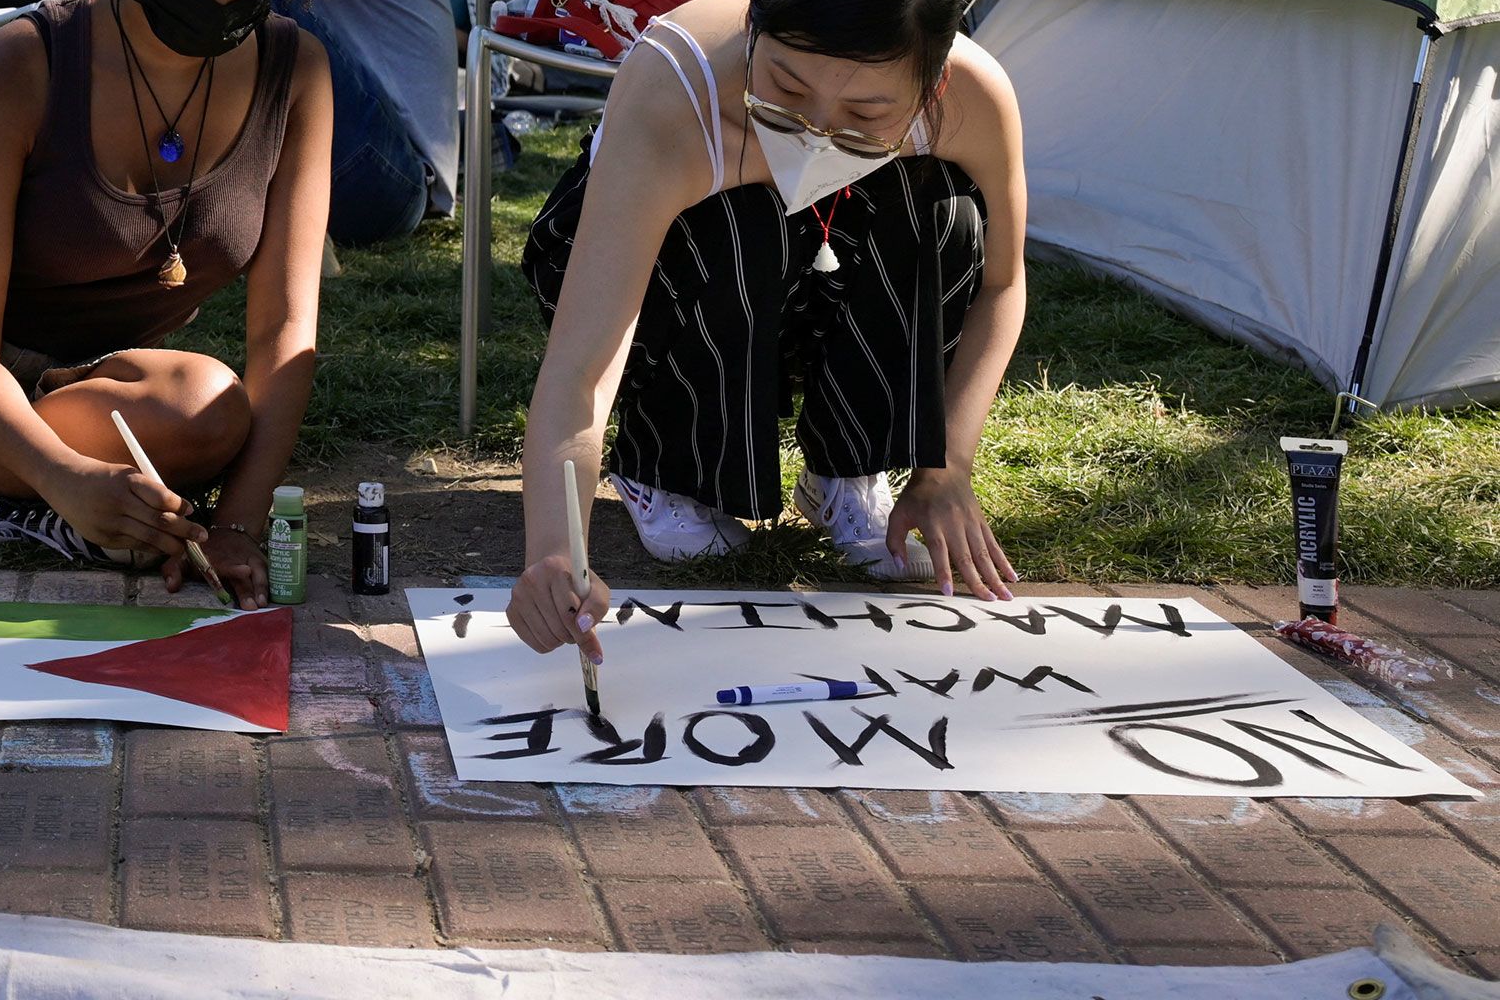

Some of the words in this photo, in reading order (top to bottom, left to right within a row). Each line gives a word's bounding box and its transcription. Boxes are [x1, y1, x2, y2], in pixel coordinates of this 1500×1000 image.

[1292, 465, 1336, 477] PLAZA
[1297, 496, 1318, 564] ACRYLIC
[451, 592, 1194, 639] MACHIN!
[465, 703, 954, 771] MORE
[1106, 708, 1423, 788] NO
[176, 838, 210, 900] CRAWFORD
[216, 840, 248, 860] 2011
[1066, 872, 1139, 910] JASON
[1085, 852, 1183, 914] CALLAHAN
[382, 904, 419, 928] 2011
